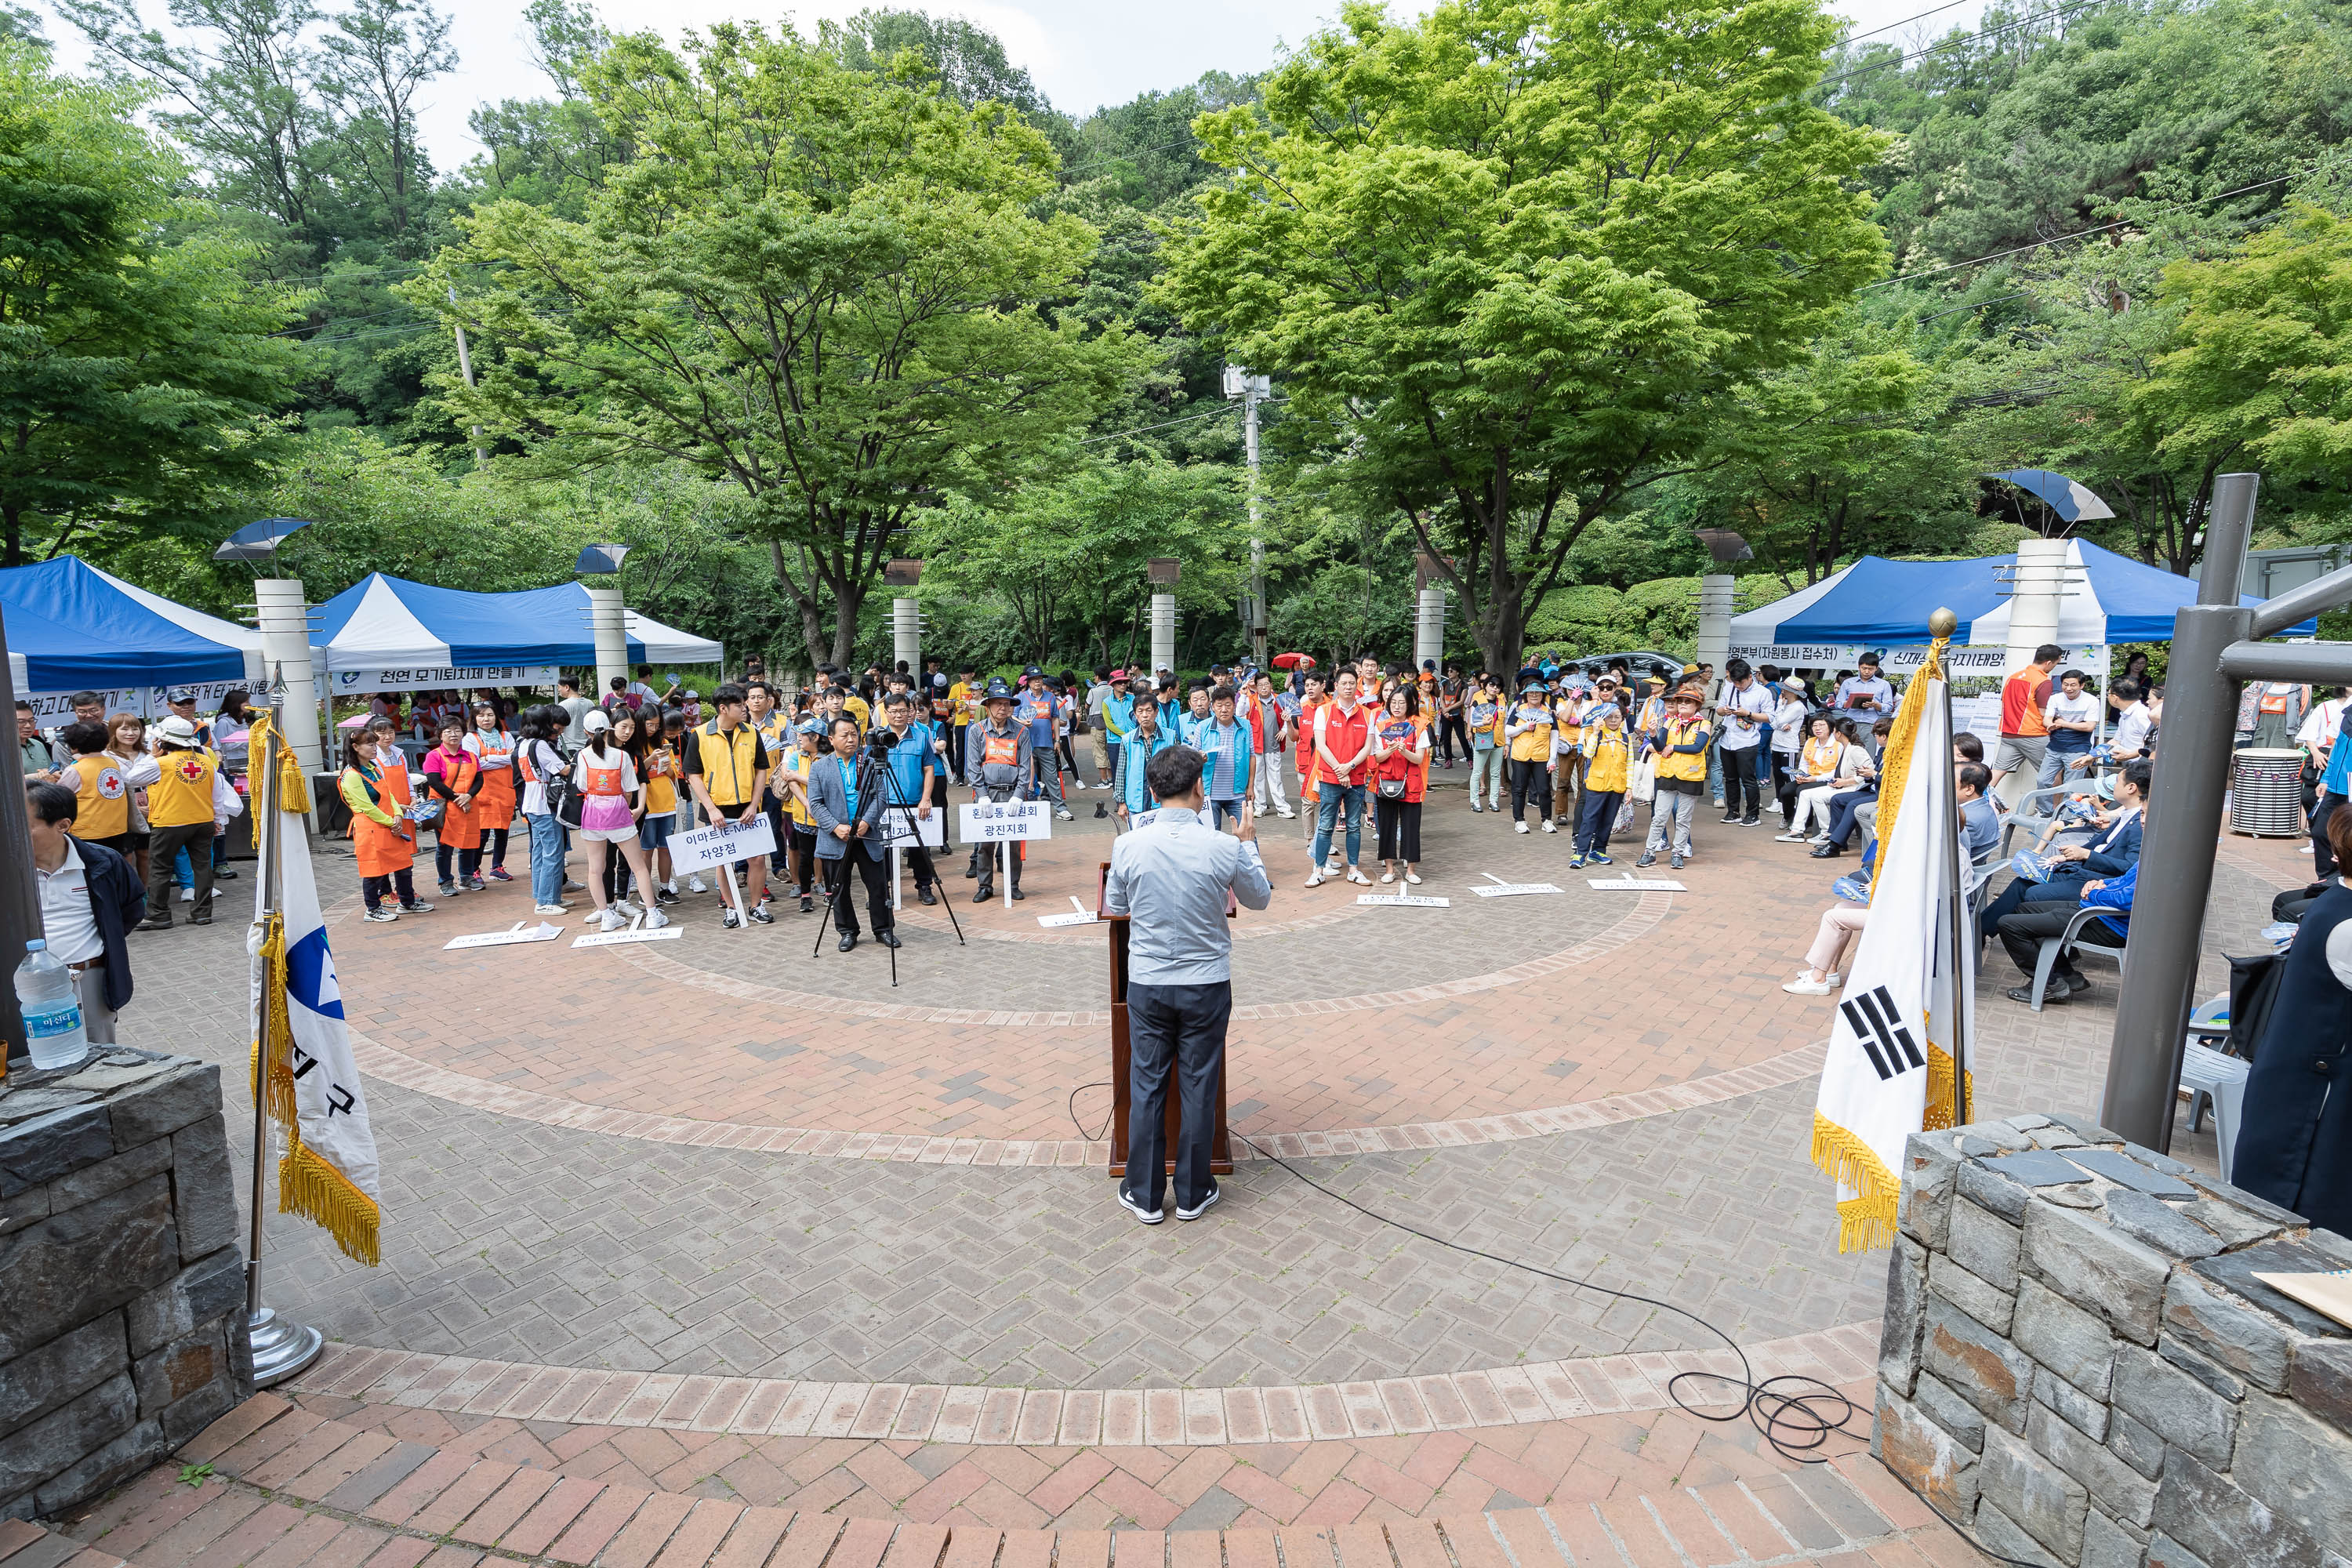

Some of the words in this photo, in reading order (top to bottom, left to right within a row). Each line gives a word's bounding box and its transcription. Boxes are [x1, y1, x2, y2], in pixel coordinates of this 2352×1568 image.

[1802, 647, 1838, 660] 접수처)
[380, 670, 410, 684] 천연
[415, 667, 483, 682] 모기퇴치제
[488, 666, 525, 679] 만들기
[29, 696, 56, 716] 하고
[985, 823, 1027, 837] 광진지회
[699, 843, 736, 860] 자양점
